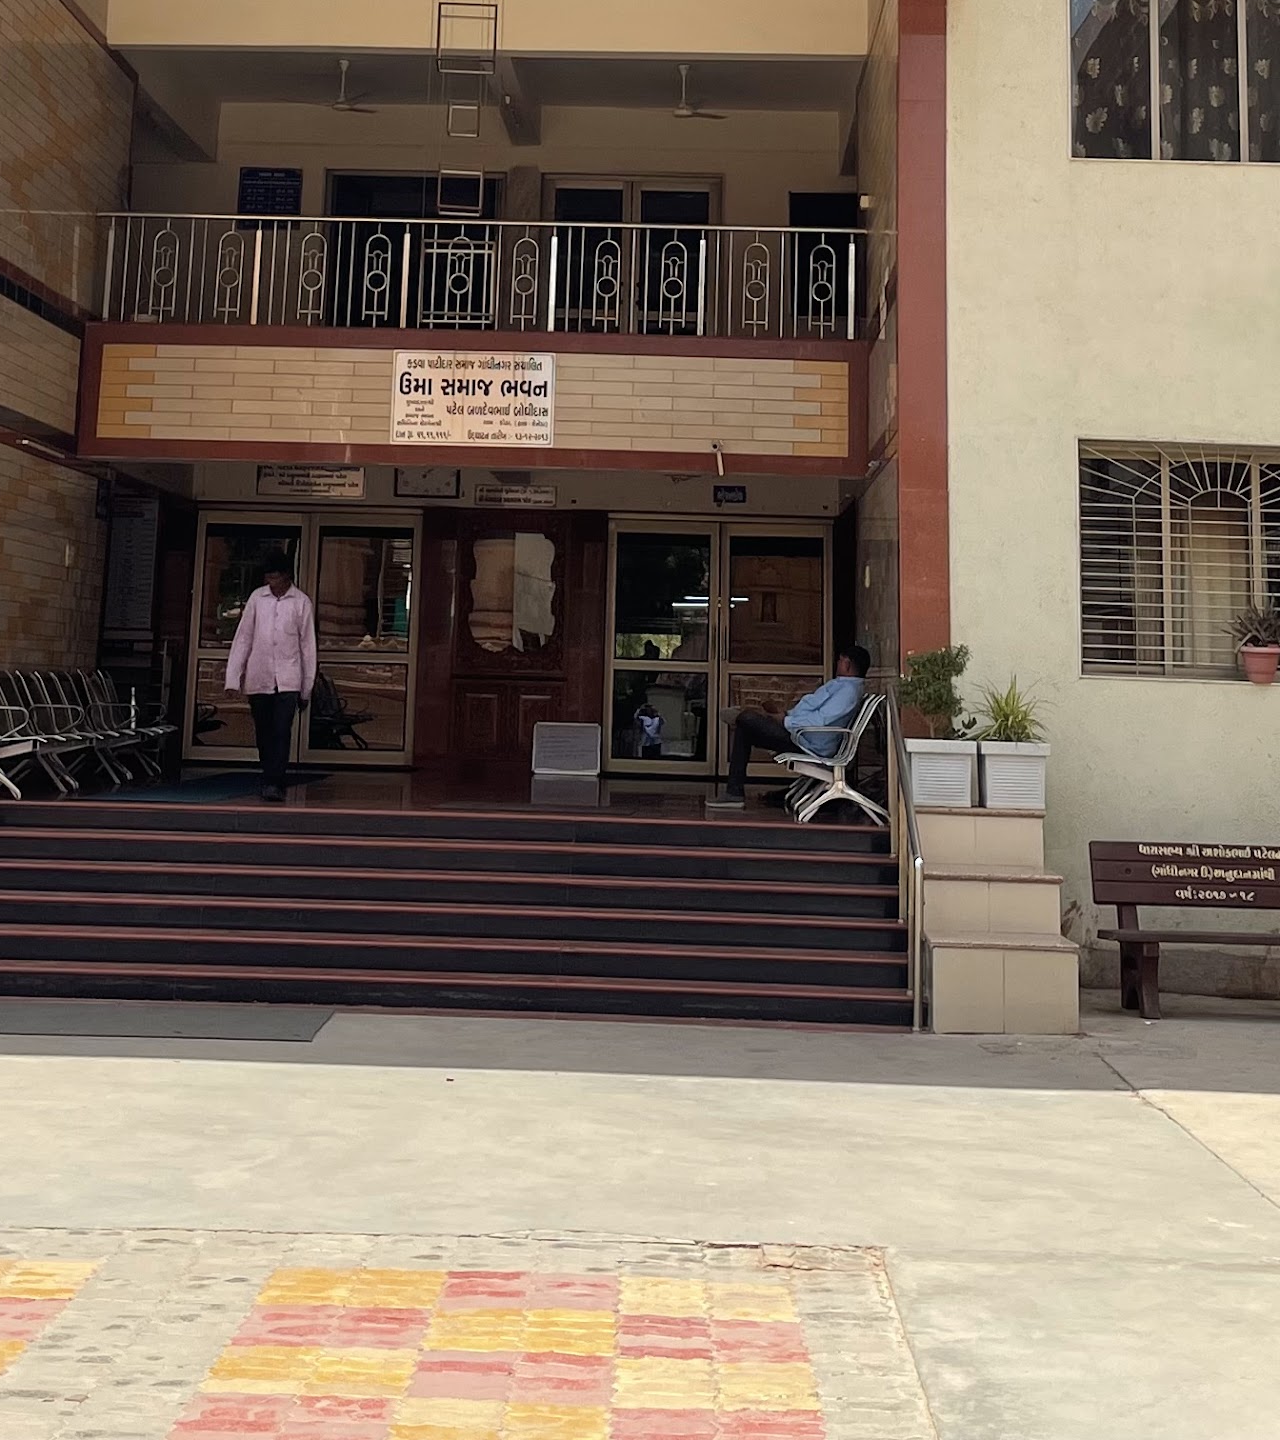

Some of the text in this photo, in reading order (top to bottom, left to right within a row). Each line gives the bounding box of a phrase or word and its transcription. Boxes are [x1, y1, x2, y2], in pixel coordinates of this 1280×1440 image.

[399, 371, 548, 398] ઉમા સમાજ ભવન
[446, 401, 464, 416] પટેલ
